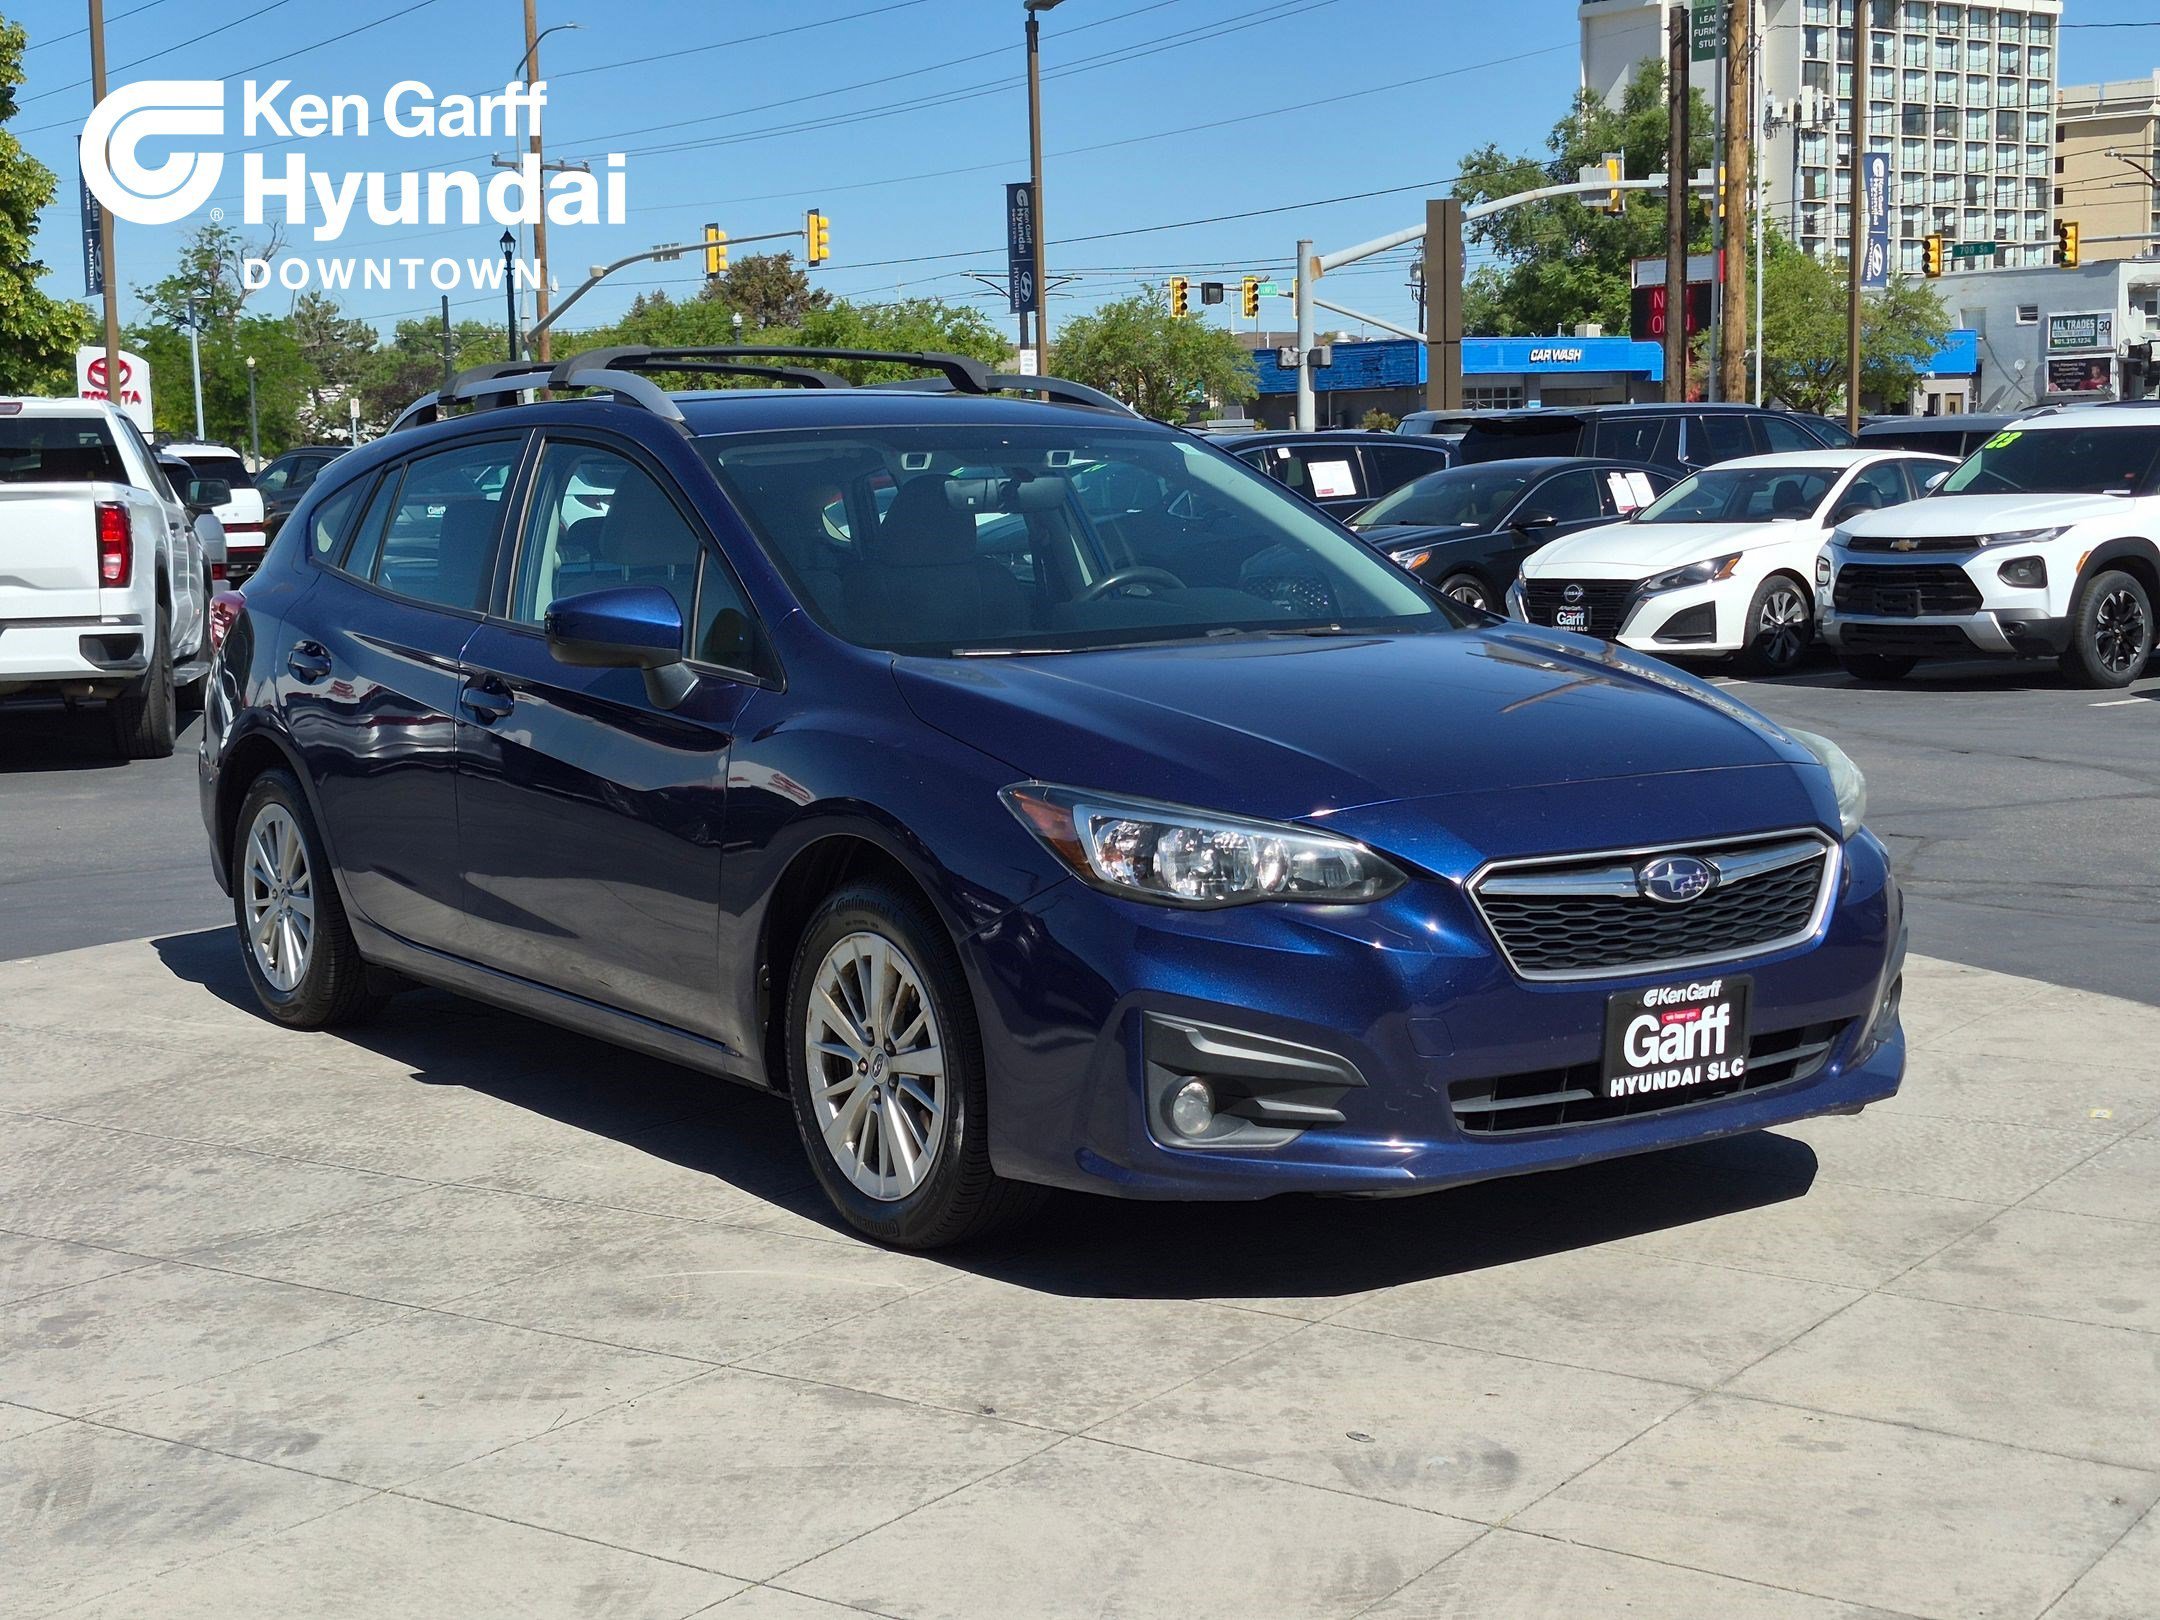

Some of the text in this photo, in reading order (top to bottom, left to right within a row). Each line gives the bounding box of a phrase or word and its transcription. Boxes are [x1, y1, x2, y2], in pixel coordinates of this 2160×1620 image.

[1015, 208, 1026, 254] Hyundai
[2052, 318, 2096, 330] ALL TRADES
[2098, 320, 2112, 332] 30
[1530, 349, 1581, 361] CAR WASH
[82, 390, 142, 405] TOYTA
[1984, 431, 2023, 449] 23
[1556, 611, 1585, 626] Garff
[1623, 1003, 1730, 1068] Garff
[1610, 1057, 1744, 1098] HYUNDAI SLC
